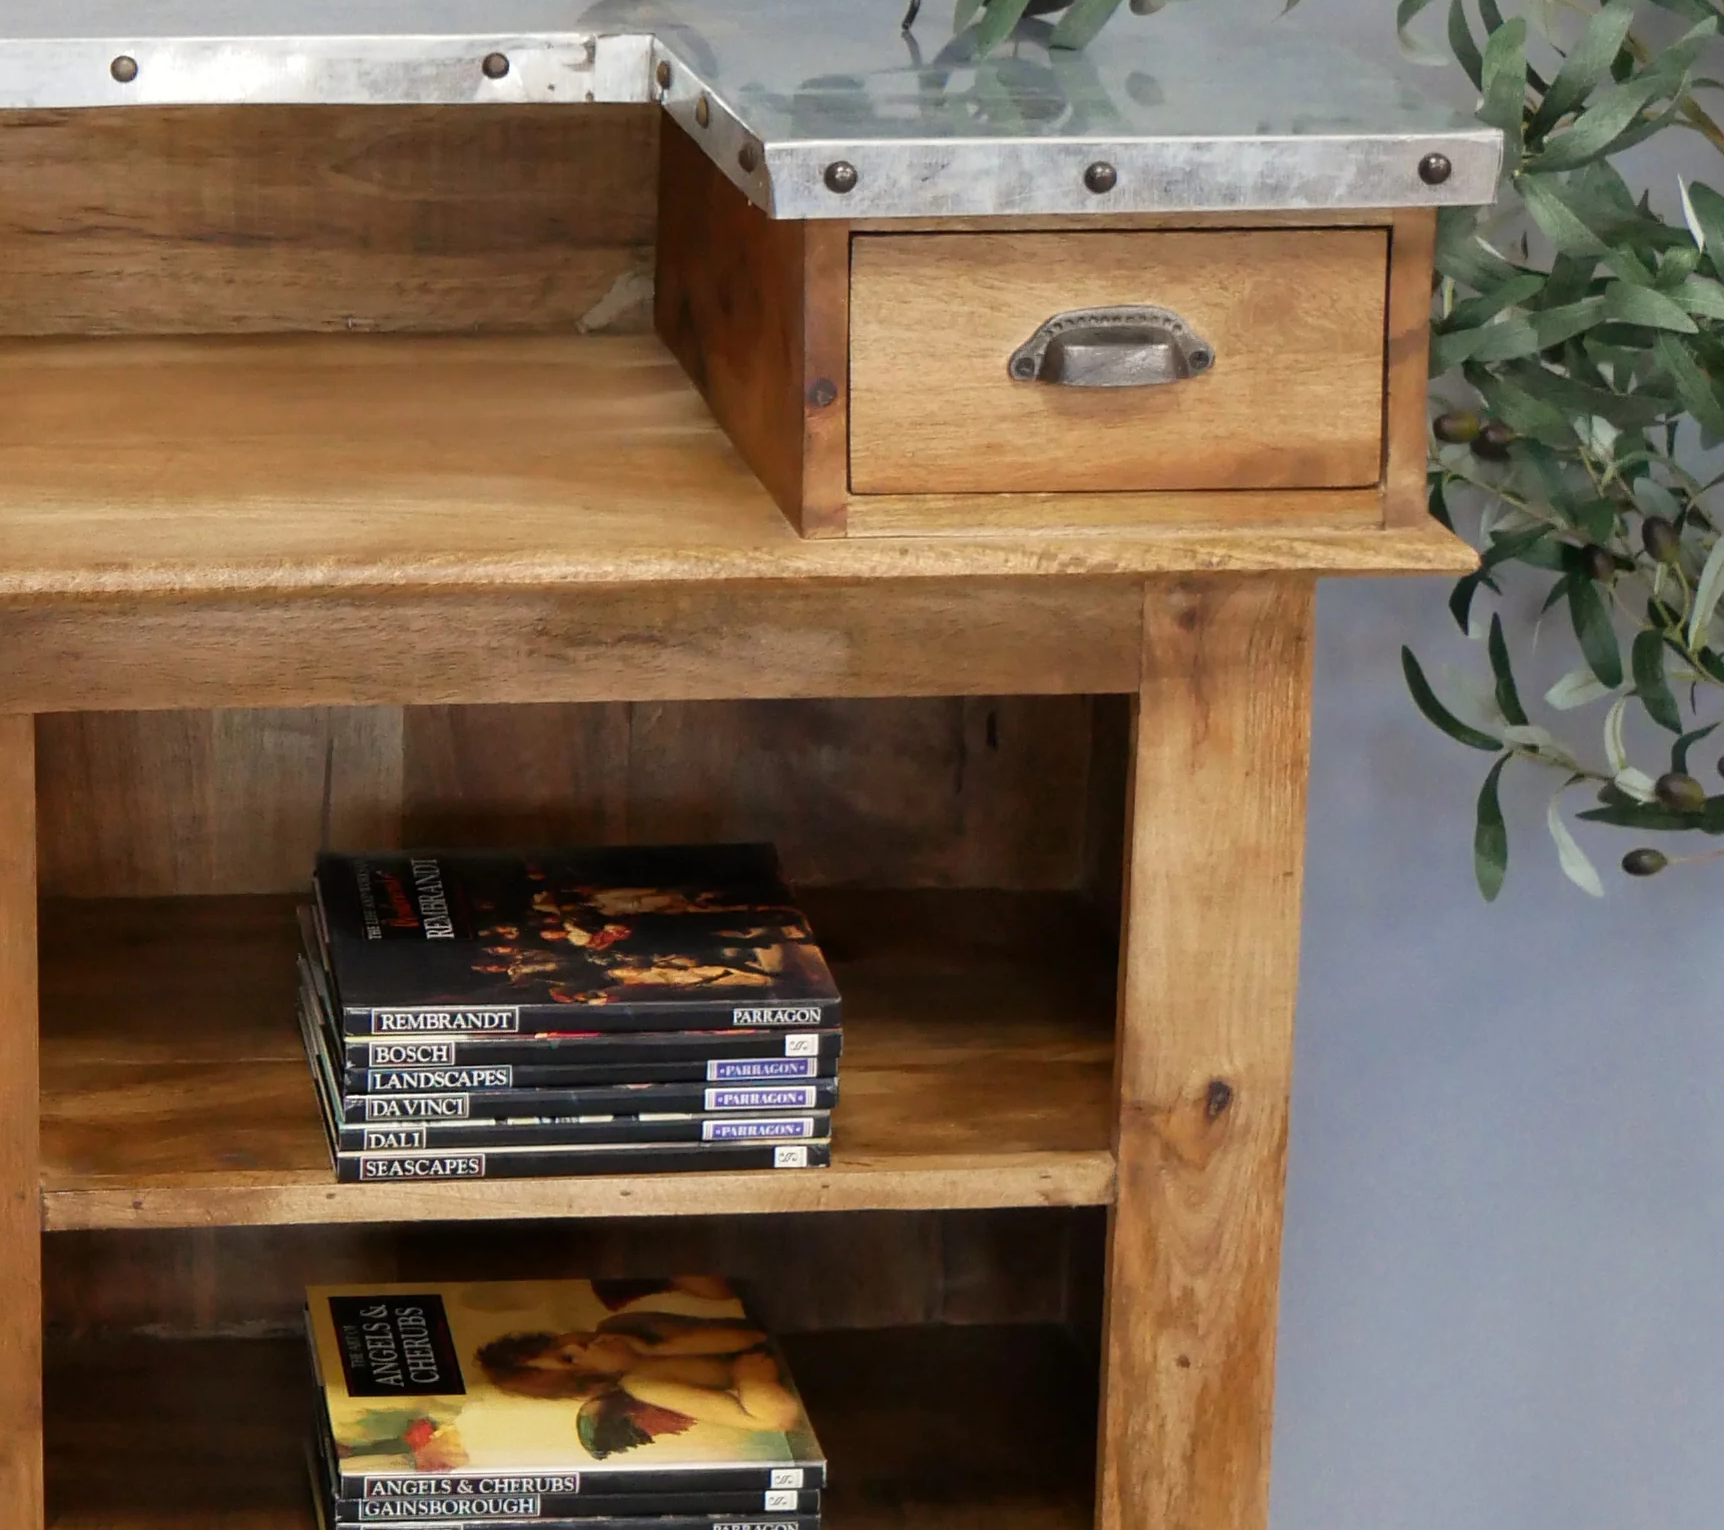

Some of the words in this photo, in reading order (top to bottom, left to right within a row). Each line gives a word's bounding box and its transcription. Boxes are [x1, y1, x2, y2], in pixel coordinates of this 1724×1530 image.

[410, 858, 455, 940] REMBRANDT
[380, 1014, 512, 1030] REMBRANDT
[733, 1008, 821, 1023] PARRAGON
[375, 1046, 448, 1063] BOSCH
[374, 1071, 507, 1087] LANDSCAPES
[371, 1099, 401, 1117] DA
[403, 1099, 465, 1116] VINCI
[368, 1134, 421, 1150] DALI
[366, 1159, 480, 1177] SEASCAPES
[360, 1304, 388, 1318] &
[395, 1306, 440, 1384] CHERUBS
[362, 1322, 405, 1387] ANGELS
[371, 1479, 452, 1495] ANGELS
[456, 1478, 475, 1494] &
[478, 1477, 575, 1493] CHERUBS
[364, 1500, 535, 1516] GAINSBOROUGH
